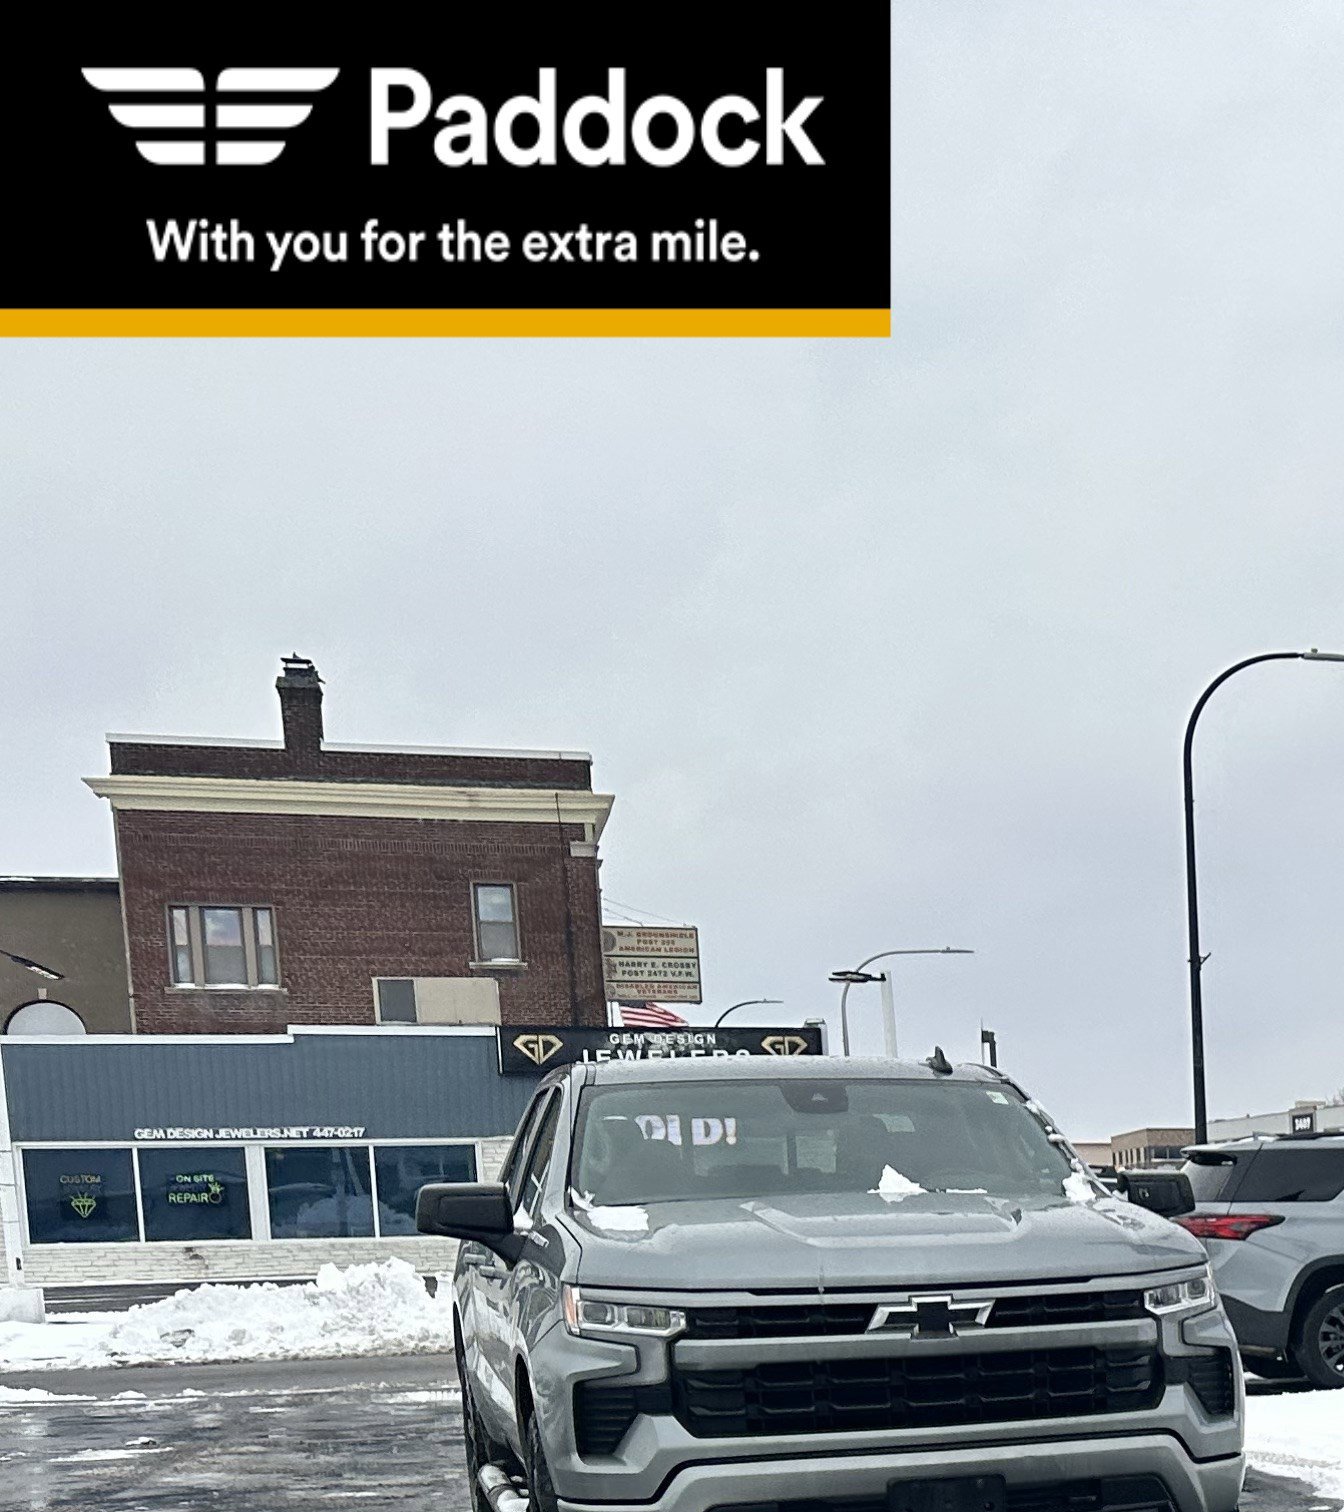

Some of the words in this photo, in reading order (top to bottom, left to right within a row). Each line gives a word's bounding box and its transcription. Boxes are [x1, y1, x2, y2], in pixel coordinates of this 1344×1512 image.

[609, 1033, 645, 1045] GEM
[653, 1033, 717, 1045] DESIGN
[134, 1127, 165, 1139] GEM
[167, 1127, 214, 1139] DESIGN
[215, 1127, 309, 1139] JEWELERS.NET
[176, 1174, 191, 1183] ON
[193, 1174, 214, 1183] SITE
[168, 1192, 209, 1204] REPAIR
